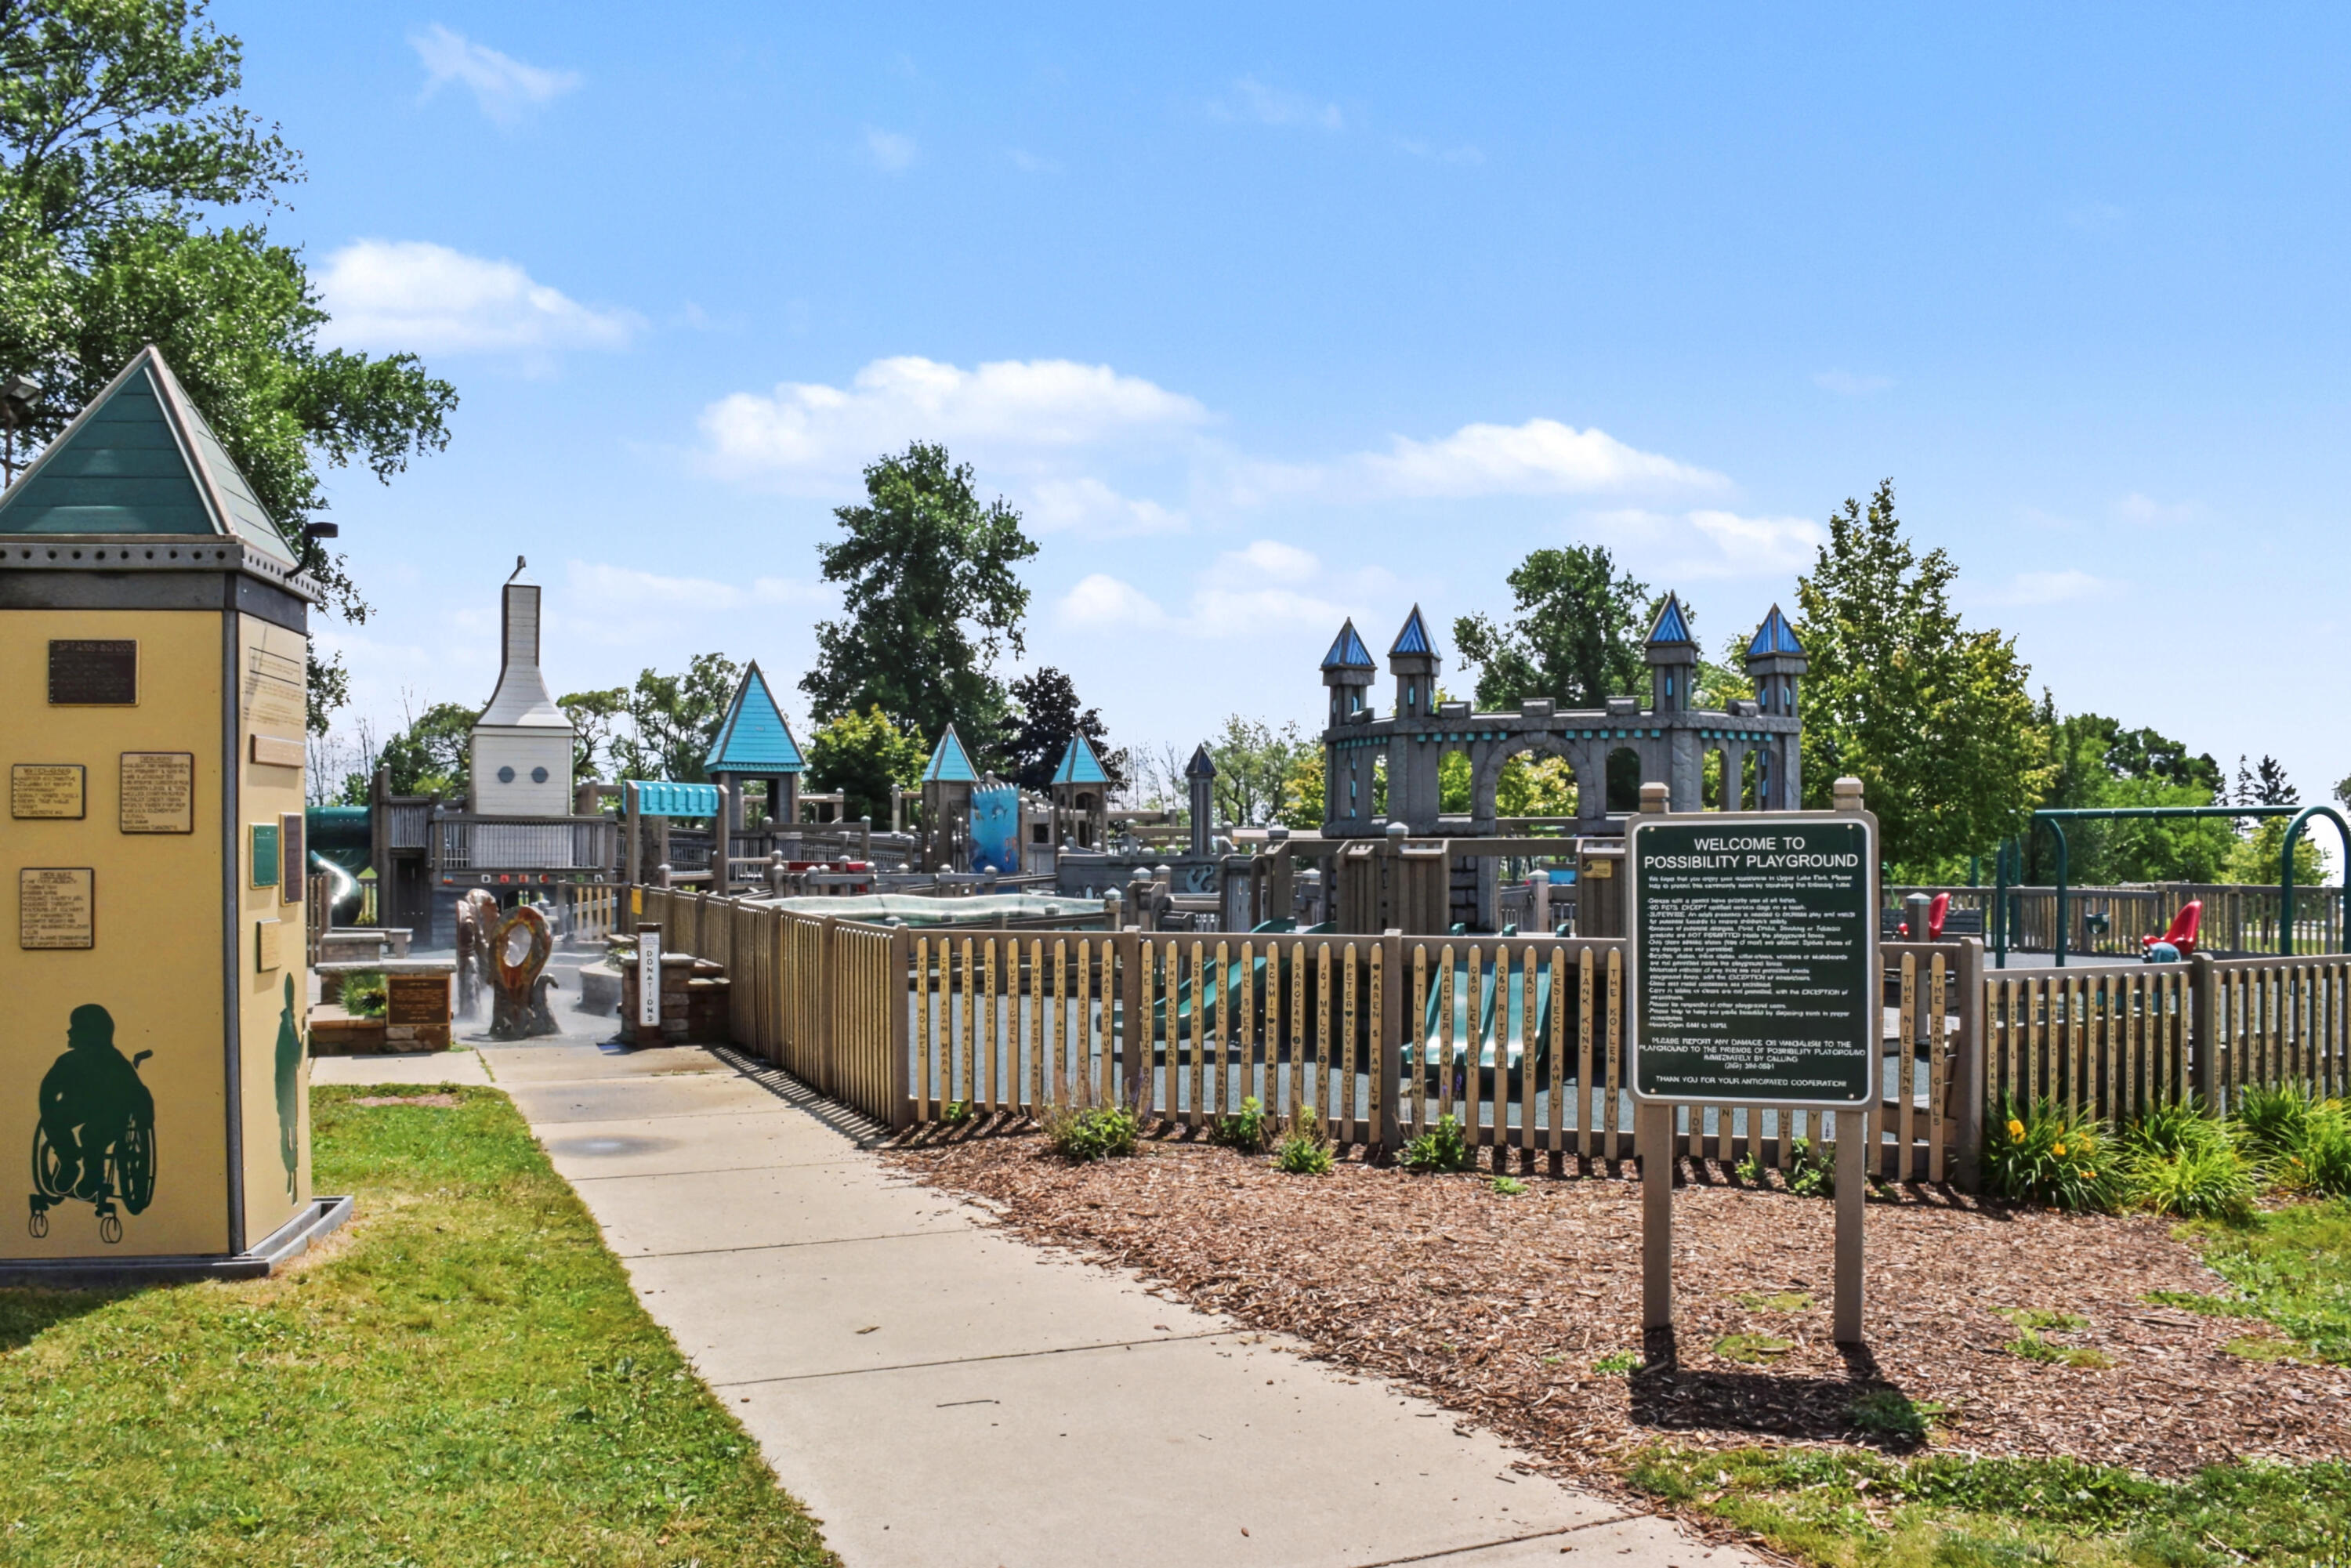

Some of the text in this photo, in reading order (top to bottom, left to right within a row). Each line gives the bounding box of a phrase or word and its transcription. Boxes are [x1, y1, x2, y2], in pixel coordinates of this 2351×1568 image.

[1644, 854, 1859, 869] POSSIBILITY PLAYGROUND
[1694, 837, 1806, 851] WELCOME TO
[1218, 961, 1226, 1024] MICHAEL
[1933, 975, 1943, 1005] THE
[1608, 1008, 1617, 1064] KOLLER
[1902, 974, 1912, 1095] THE NIELSENS
[1933, 1077, 1942, 1126] GIRLS
